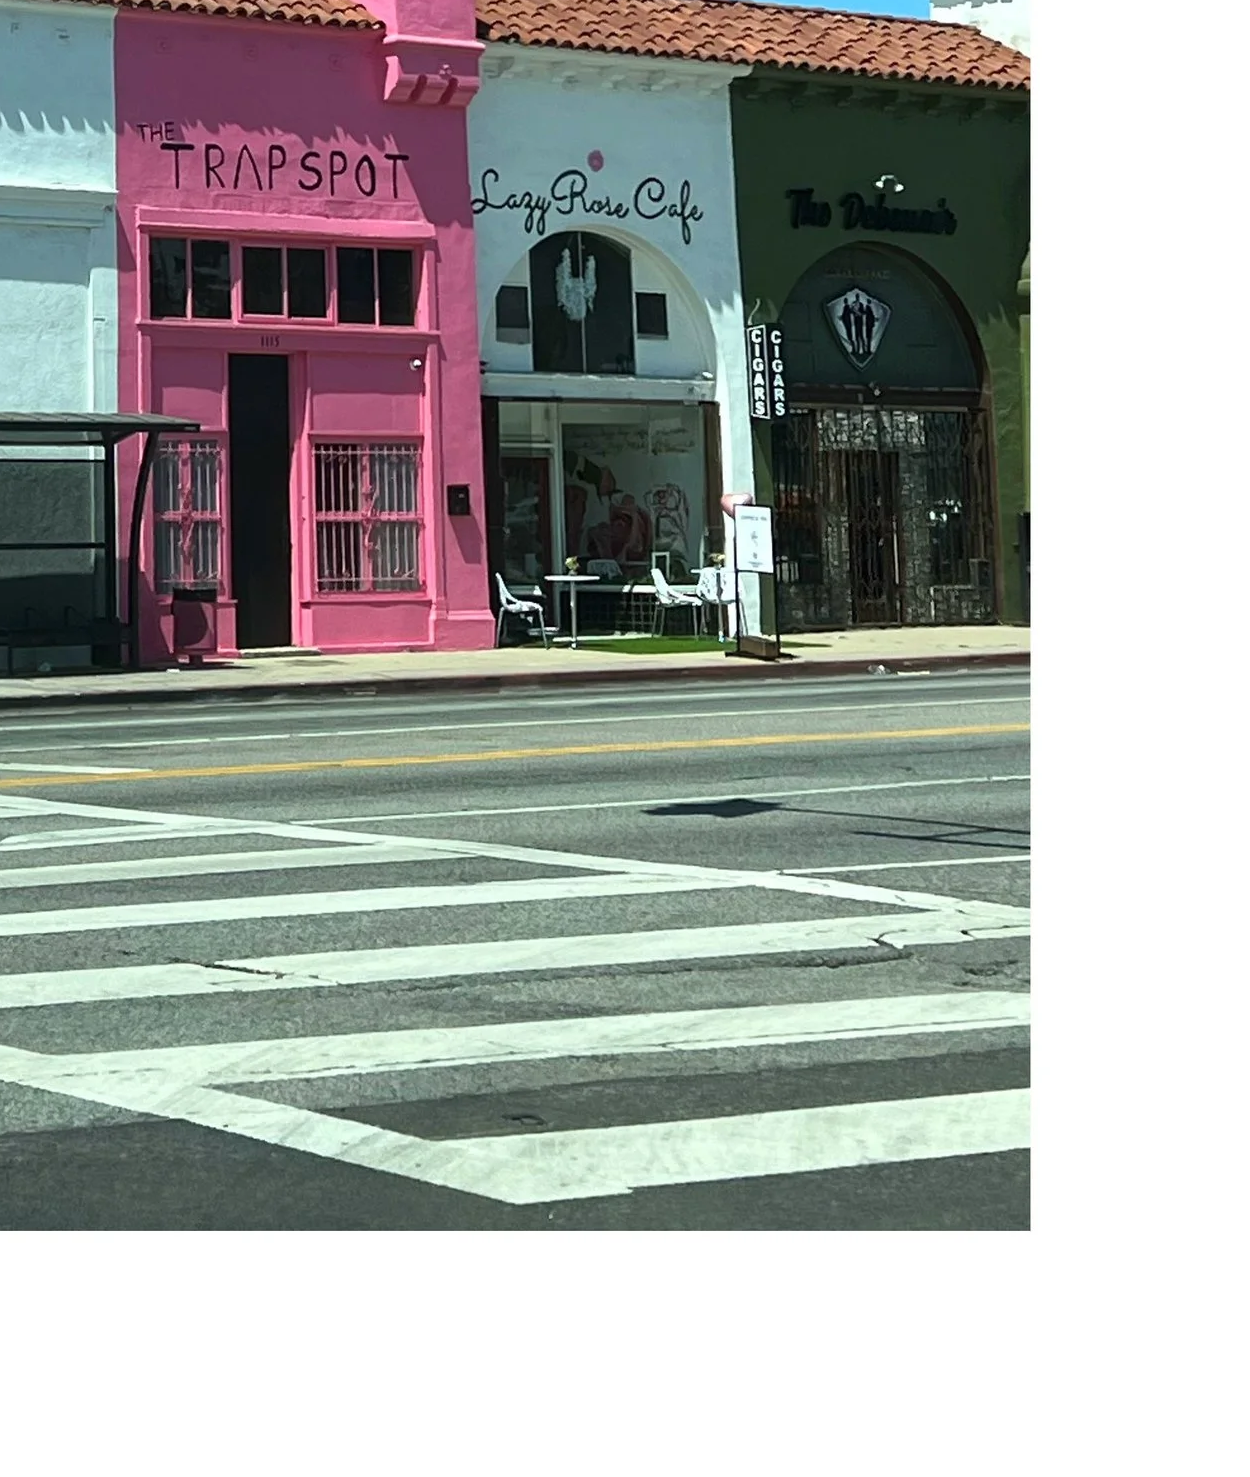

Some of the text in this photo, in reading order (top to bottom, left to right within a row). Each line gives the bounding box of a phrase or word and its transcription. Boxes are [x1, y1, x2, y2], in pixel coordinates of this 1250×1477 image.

[136, 121, 175, 142] THE
[160, 142, 410, 199] TRAP SPOT
[471, 168, 704, 245] Lazy Rose Cafe
[784, 188, 832, 229] The
[751, 329, 765, 415] CIGARS
[770, 330, 785, 416] CIGARS
